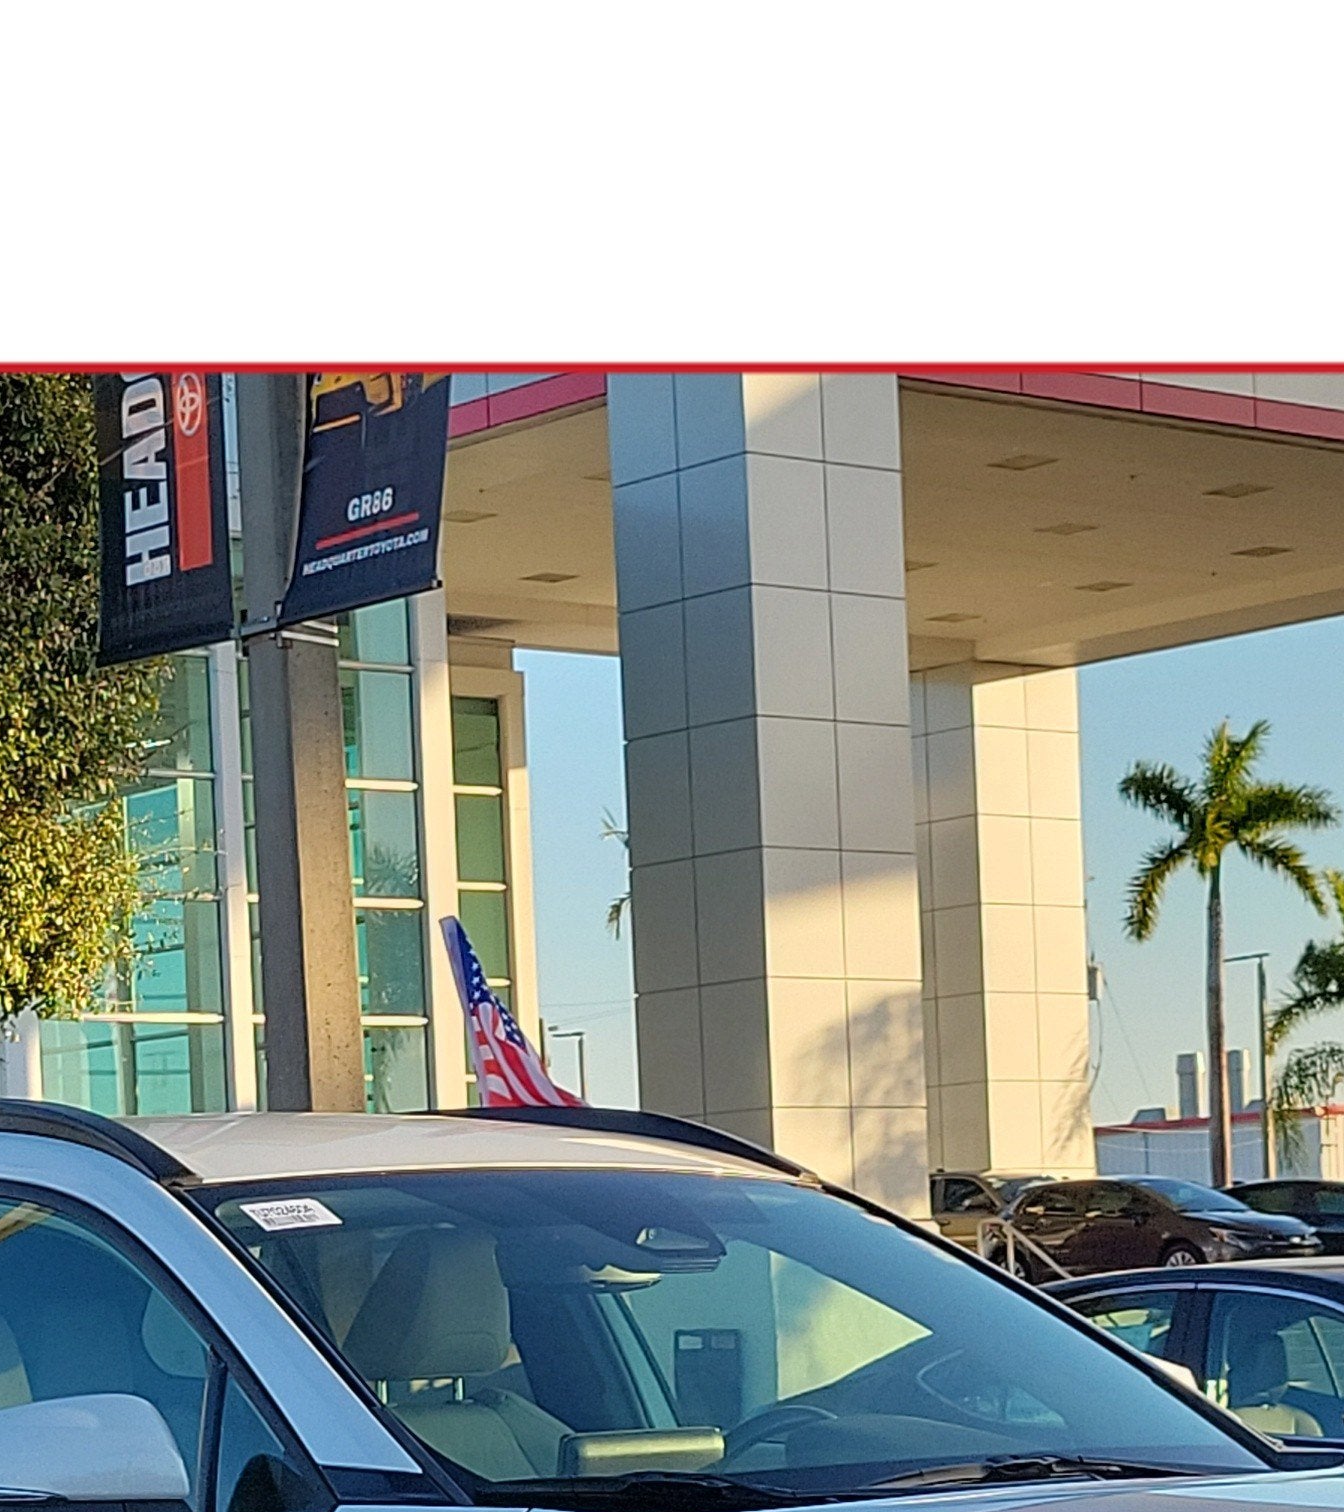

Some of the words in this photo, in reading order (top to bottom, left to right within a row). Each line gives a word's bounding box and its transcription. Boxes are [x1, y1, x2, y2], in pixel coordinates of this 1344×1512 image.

[121, 373, 172, 587] HEAD
[347, 487, 393, 521] GR86
[302, 528, 429, 576] HEADQUARTERTOYOTA.COM
